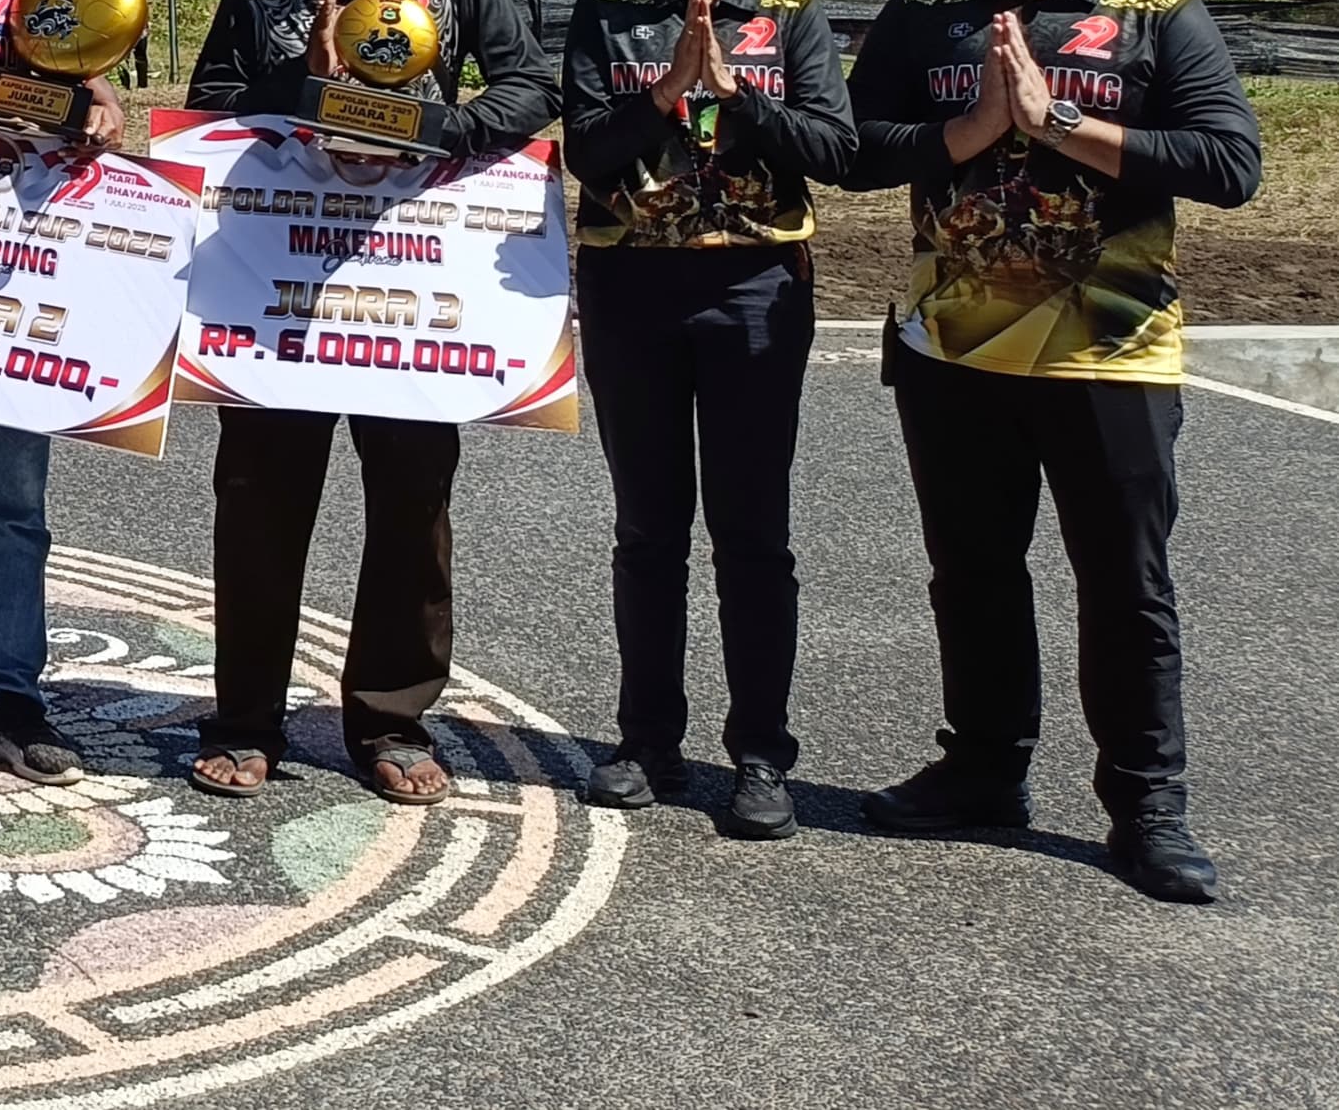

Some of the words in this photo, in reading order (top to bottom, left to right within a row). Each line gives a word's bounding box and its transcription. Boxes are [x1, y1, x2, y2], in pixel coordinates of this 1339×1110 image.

[8, 90, 44, 105] JUARA
[47, 98, 54, 107] 2
[328, 92, 368, 106] KAPOLDA
[371, 101, 389, 110] CUP
[339, 103, 386, 122] JUARA
[390, 114, 398, 124] 3
[108, 173, 136, 184] HARI
[473, 167, 555, 183] BHAYANGKARA
[106, 186, 191, 208] BHAYANGKARA
[321, 192, 392, 222] BALI
[397, 197, 458, 227] CUP
[463, 204, 546, 236] 2025
[18, 210, 83, 242] CUP
[84, 222, 175, 261] 2025
[289, 225, 442, 264] MAKEPUNG
[263, 279, 417, 328] JUARA
[428, 292, 462, 332] 3
[28, 303, 68, 343] 2
[199, 322, 264, 360] RP.
[276, 328, 526, 386] 6.000.000,-
